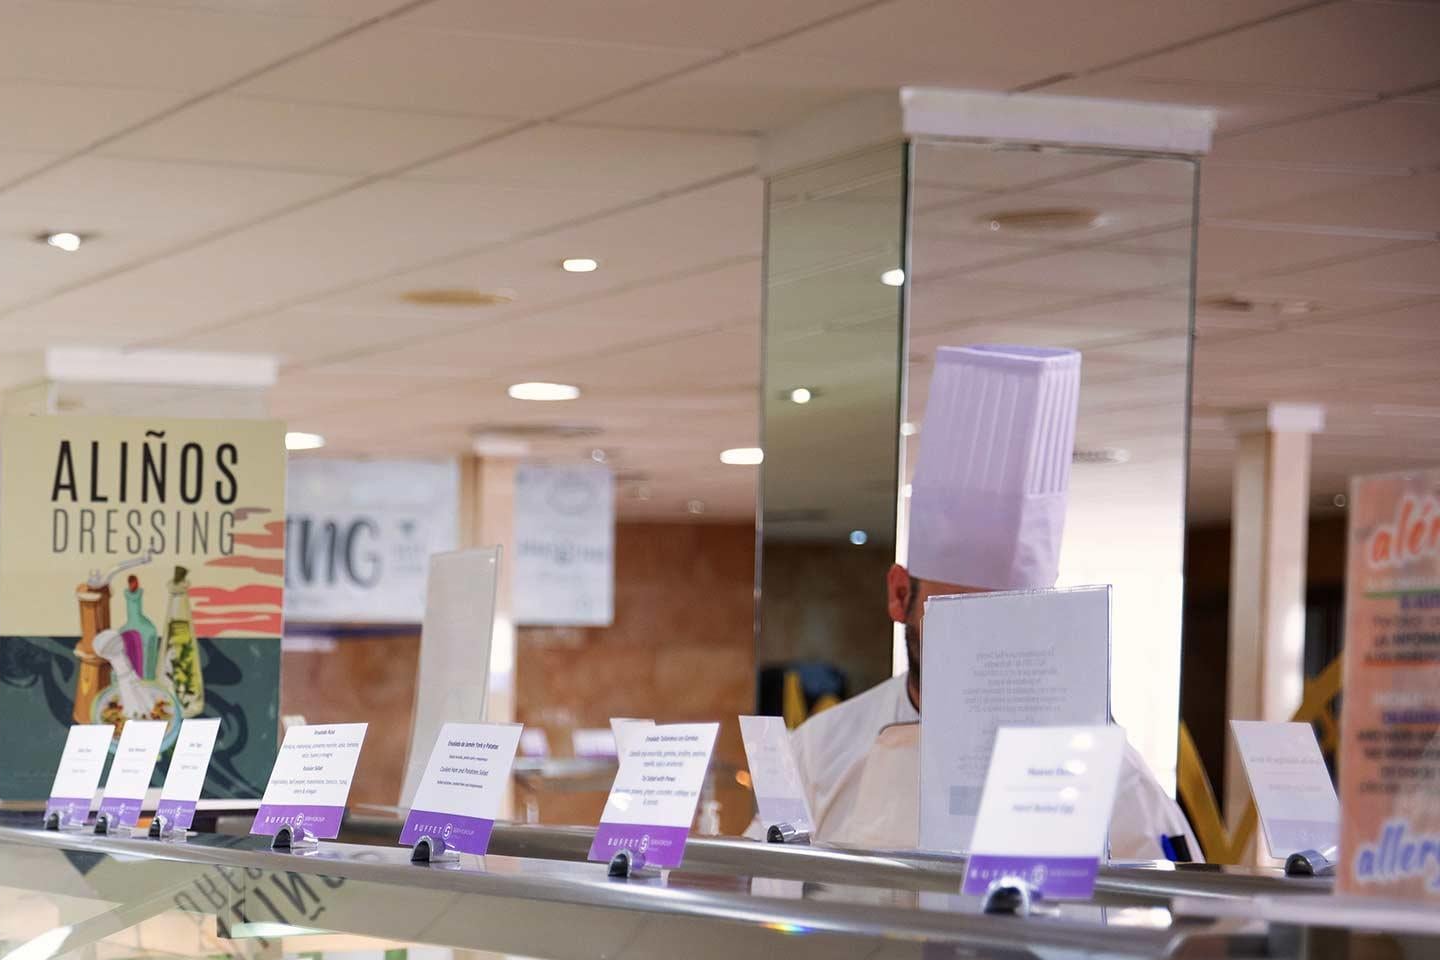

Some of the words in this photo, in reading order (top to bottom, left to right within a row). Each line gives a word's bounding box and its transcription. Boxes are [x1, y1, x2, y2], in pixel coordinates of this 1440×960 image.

[51, 430, 240, 504] ALIÑOS
[51, 508, 236, 555] DRESSING
[264, 815, 295, 824] BUFFET
[413, 823, 441, 834] BUFFET
[607, 838, 639, 847] BUFFET
